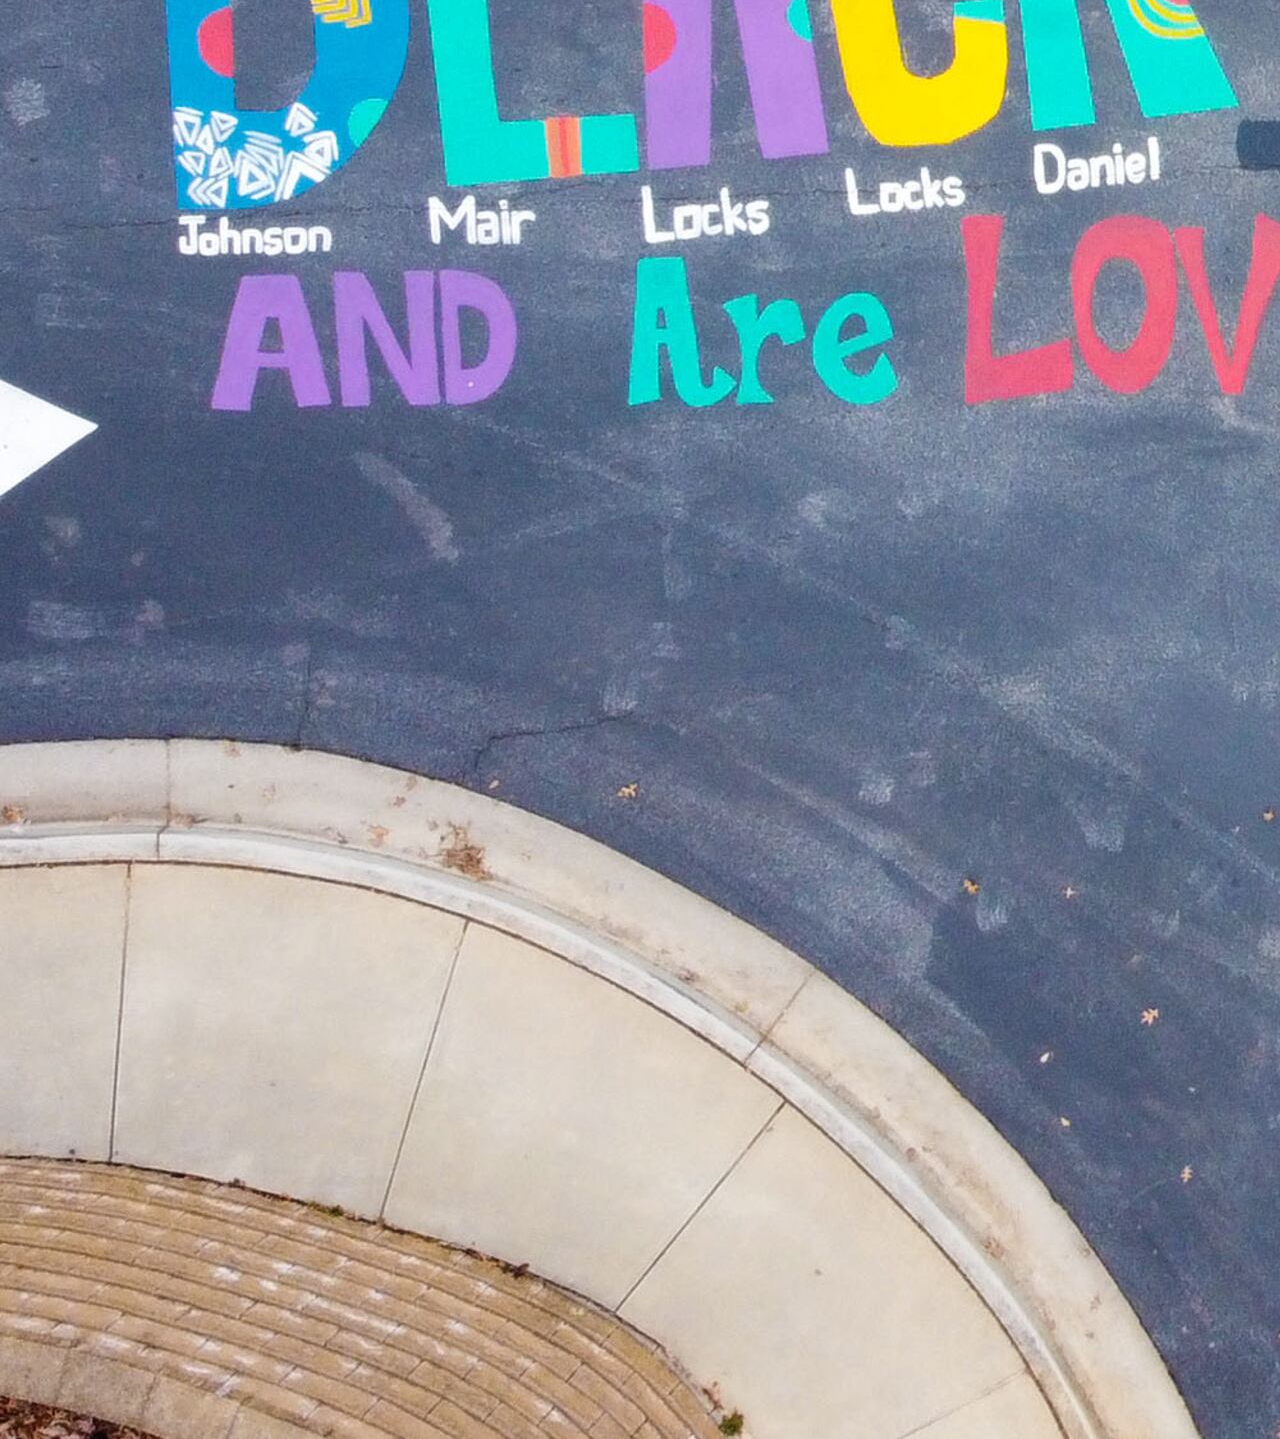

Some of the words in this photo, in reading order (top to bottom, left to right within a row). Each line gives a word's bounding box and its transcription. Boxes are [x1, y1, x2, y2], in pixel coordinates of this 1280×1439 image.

[179, 215, 331, 255] Johnson
[429, 196, 536, 244] Mair
[642, 186, 769, 243] Locks
[845, 167, 965, 215] Locks
[1034, 137, 1160, 194] Daniel
[212, 269, 517, 413] AND
[626, 255, 899, 407] Are
